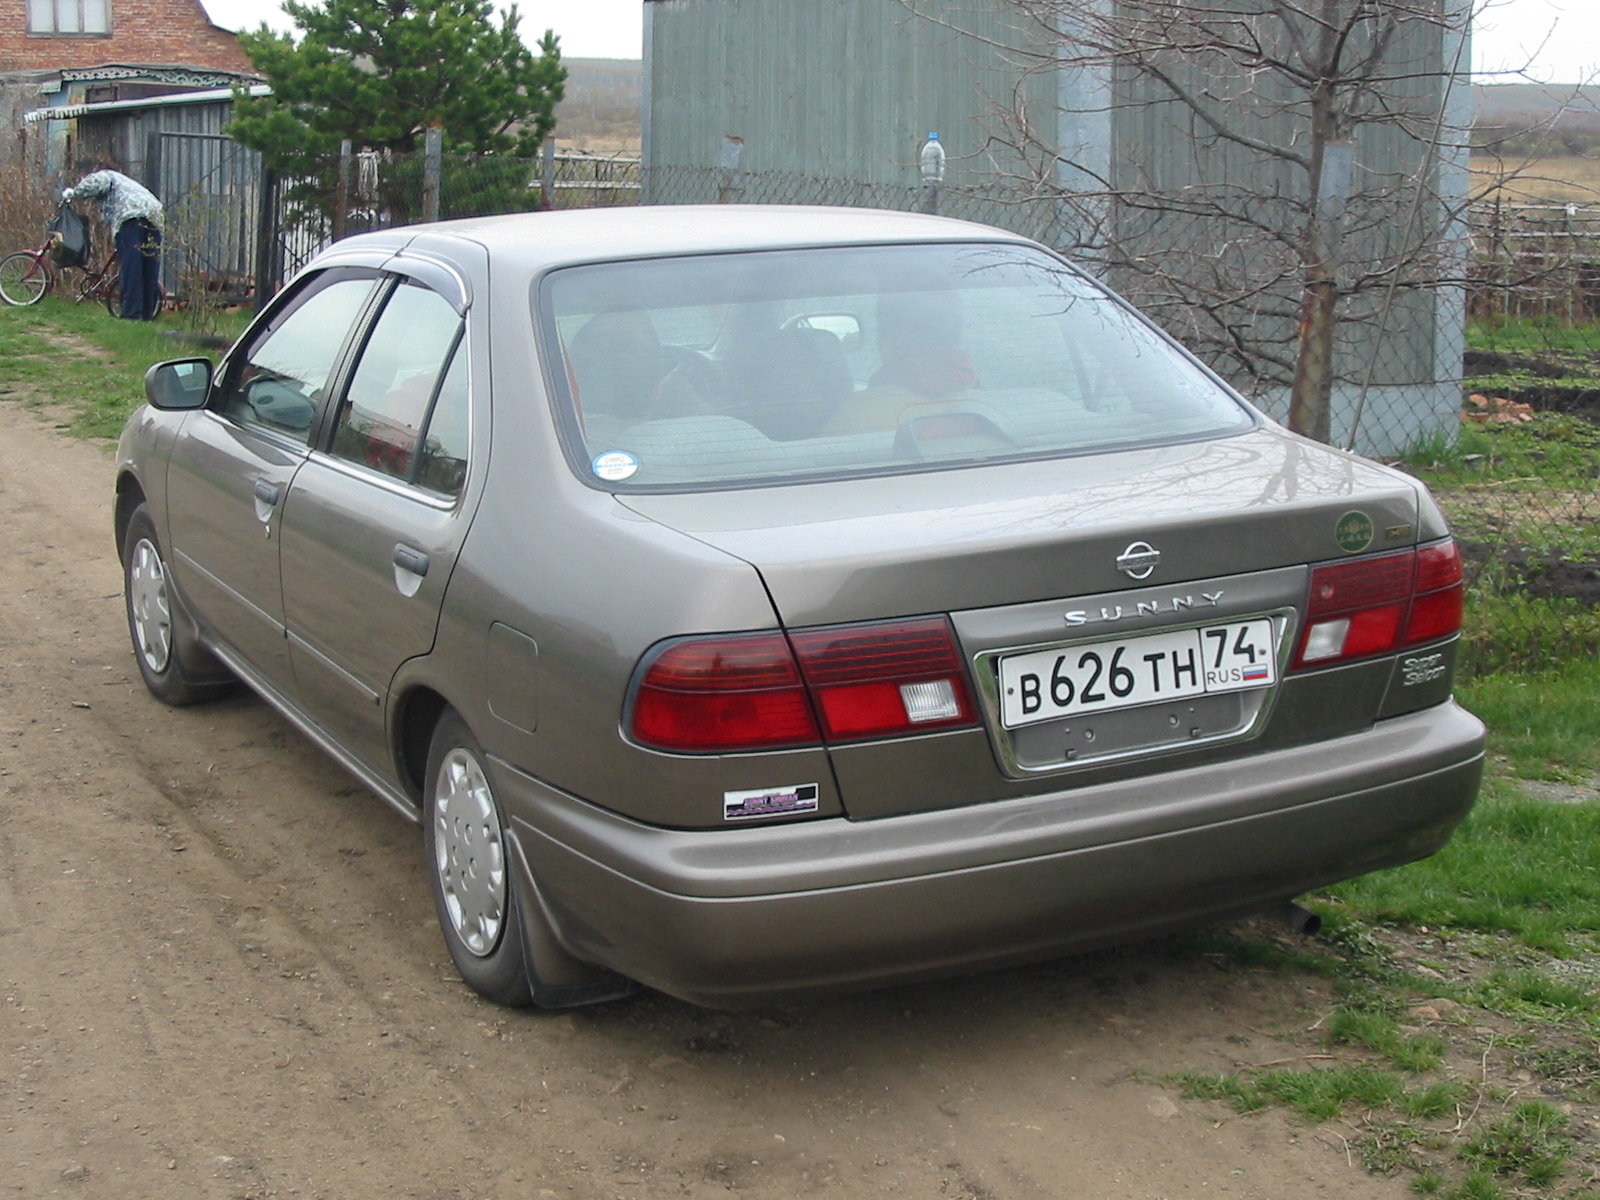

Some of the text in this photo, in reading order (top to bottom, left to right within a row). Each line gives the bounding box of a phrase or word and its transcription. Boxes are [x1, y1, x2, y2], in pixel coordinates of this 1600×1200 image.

[1064, 590, 1224, 627] SUNNY
[1206, 626, 1256, 668] 74
[1207, 668, 1242, 685] RUS
